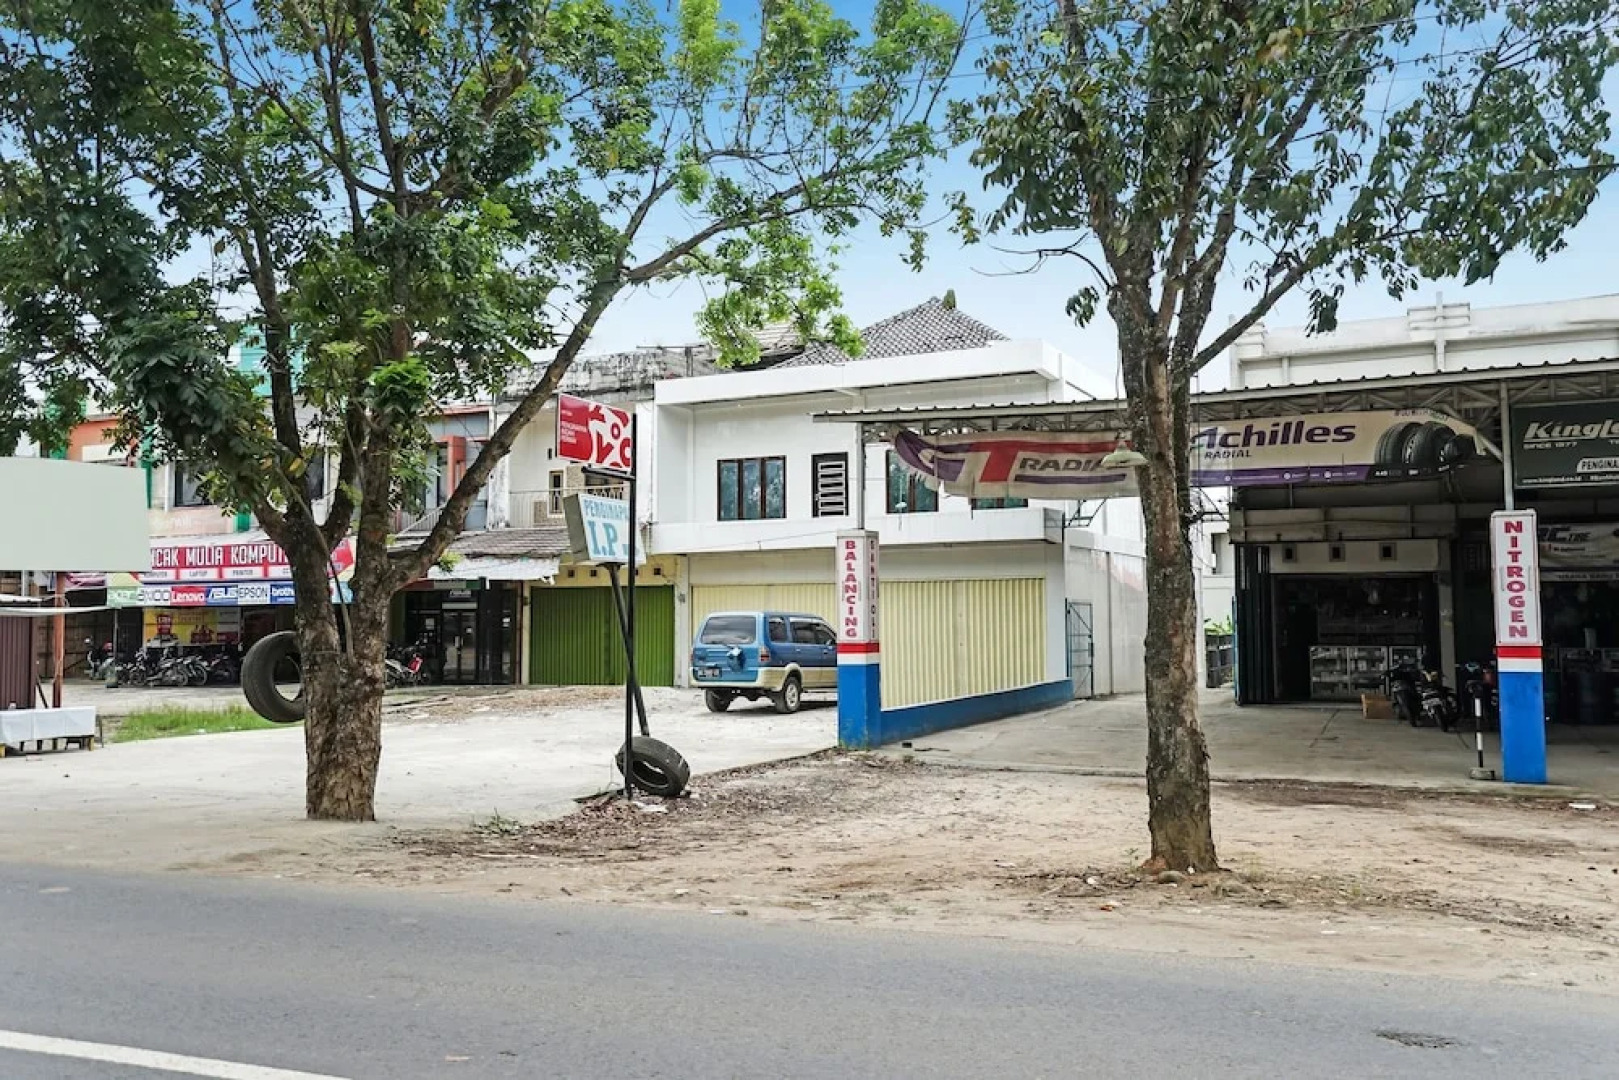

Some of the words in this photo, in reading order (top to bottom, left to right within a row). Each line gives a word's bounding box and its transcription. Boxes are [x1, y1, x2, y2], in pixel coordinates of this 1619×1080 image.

[1191, 421, 1356, 450] Achilles
[1204, 450, 1252, 460] RADIAL
[186, 546, 222, 566] MULIA
[845, 540, 857, 637] BALANCING
[1504, 521, 1528, 637] NITROGEN
[171, 590, 205, 602] Lenovo
[238, 587, 267, 598] EPSON
